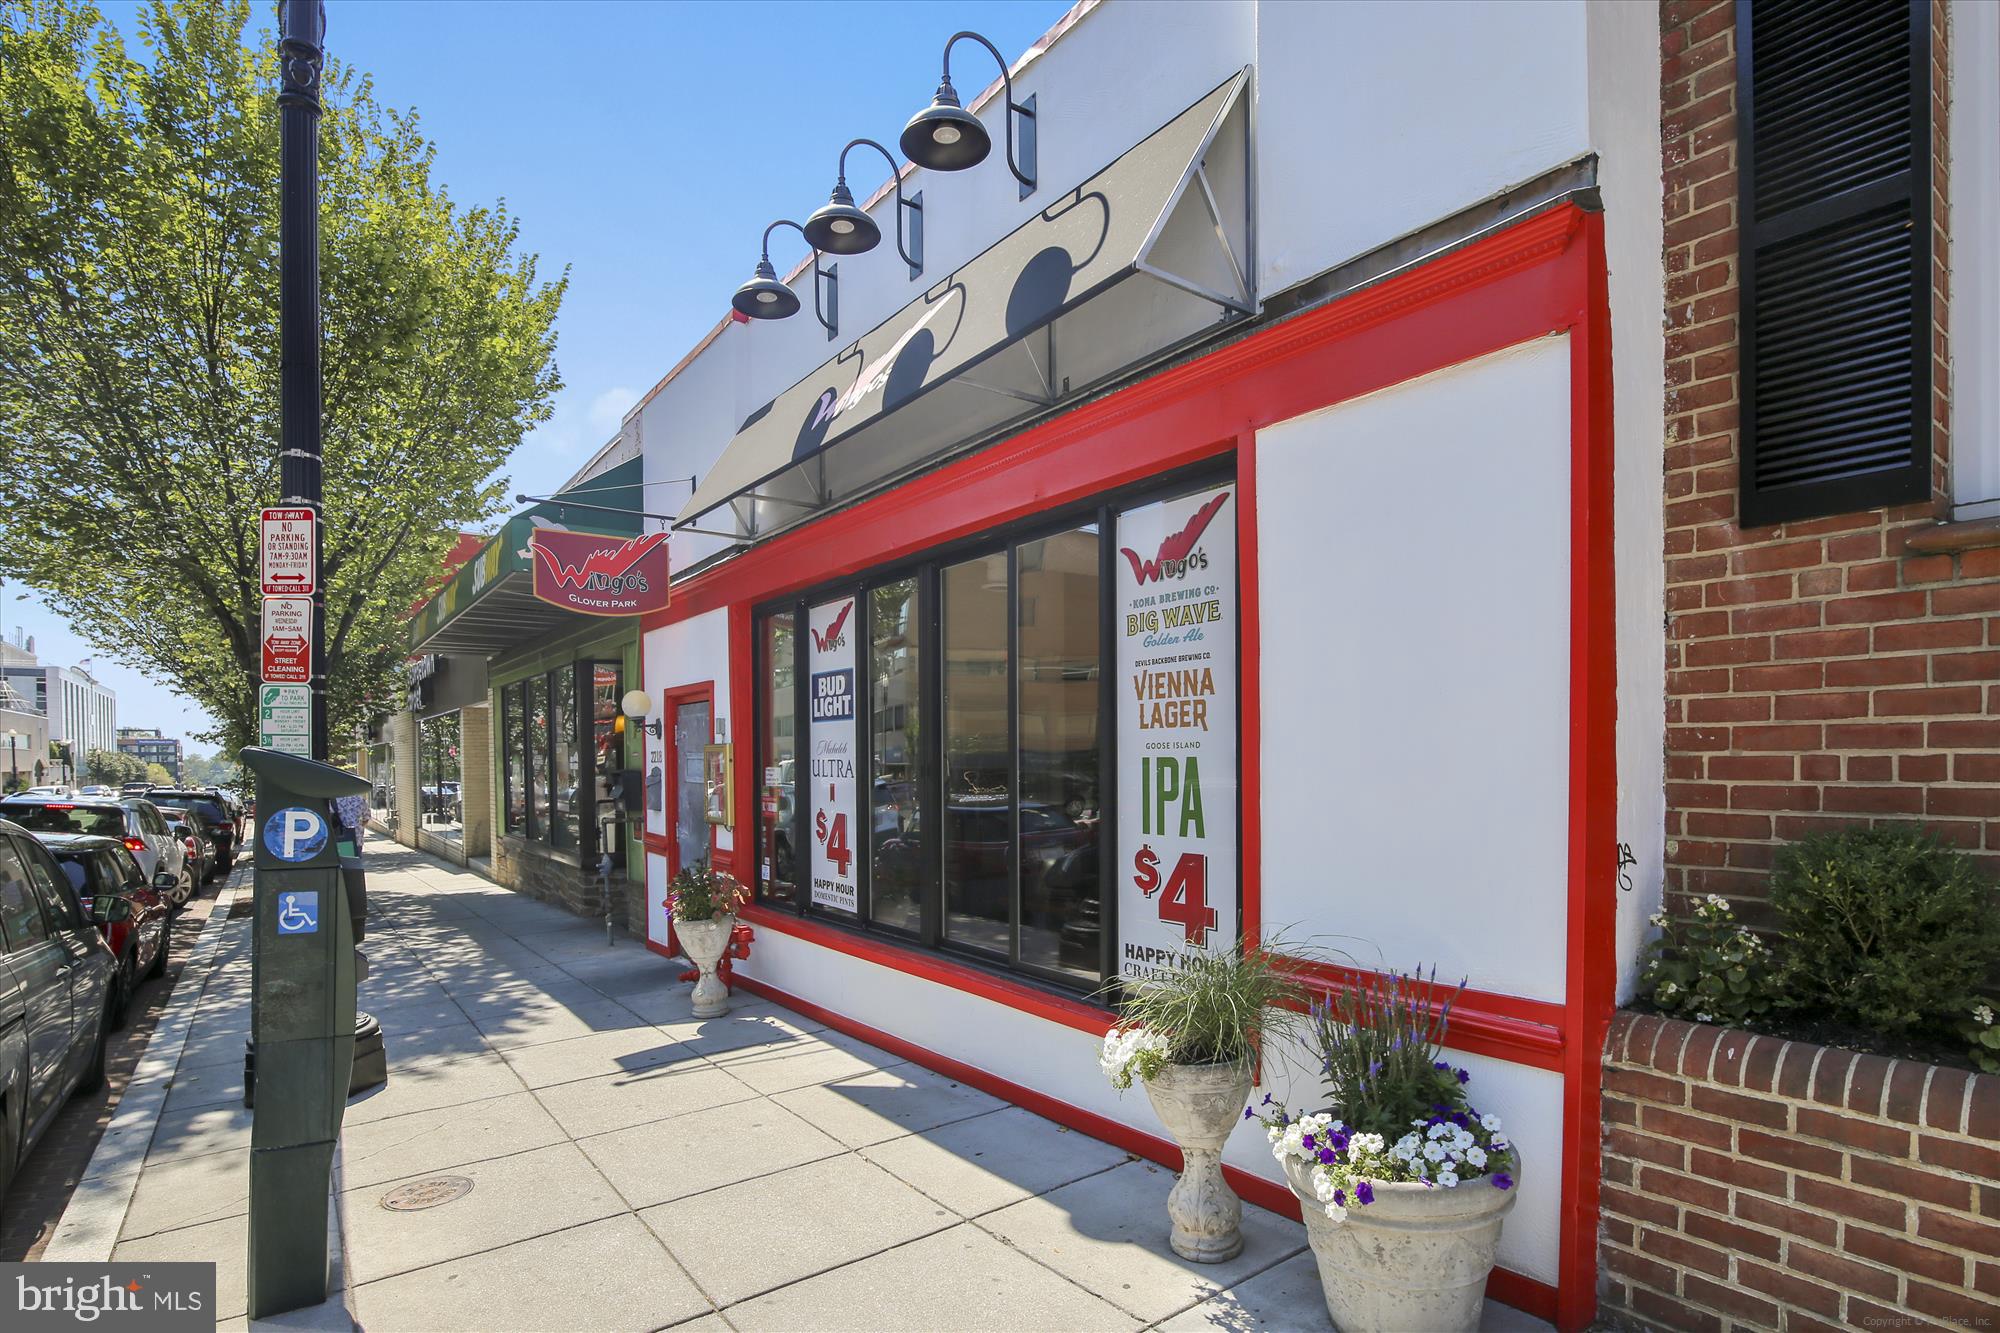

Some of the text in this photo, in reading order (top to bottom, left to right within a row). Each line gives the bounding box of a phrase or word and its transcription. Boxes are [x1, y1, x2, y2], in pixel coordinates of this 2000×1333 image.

[269, 512, 283, 520] TOW
[281, 522, 293, 532] NO
[269, 552, 308, 560] 7AM-9:30AM
[531, 533, 670, 595] Wingo's
[568, 594, 637, 608] GLOVER PARK
[1159, 588, 1201, 604] BREWING
[1126, 600, 1221, 637] BIG WAVE
[1143, 627, 1205, 648] Golden Ale
[1135, 659, 1151, 668] DEVILS
[1151, 655, 1178, 666] BACKBONE
[1178, 653, 1202, 663] BREWING
[818, 675, 846, 697] BUD
[1133, 668, 1215, 700] VIENNA
[264, 709, 271, 719] 2
[813, 695, 851, 717] LIGHT
[1139, 699, 1208, 731] LAGER
[1145, 741, 1201, 750] GOOSE ISLAND
[812, 759, 855, 778] ULTRA
[1142, 756, 1205, 839] IPA
[283, 811, 320, 858] P
[816, 807, 852, 878] $4
[814, 878, 855, 896] HAPPY HOUR
[1133, 843, 1218, 950] $4
[814, 890, 855, 907] DOMESTIC PINTS
[1125, 943, 1176, 968] HAPPY
